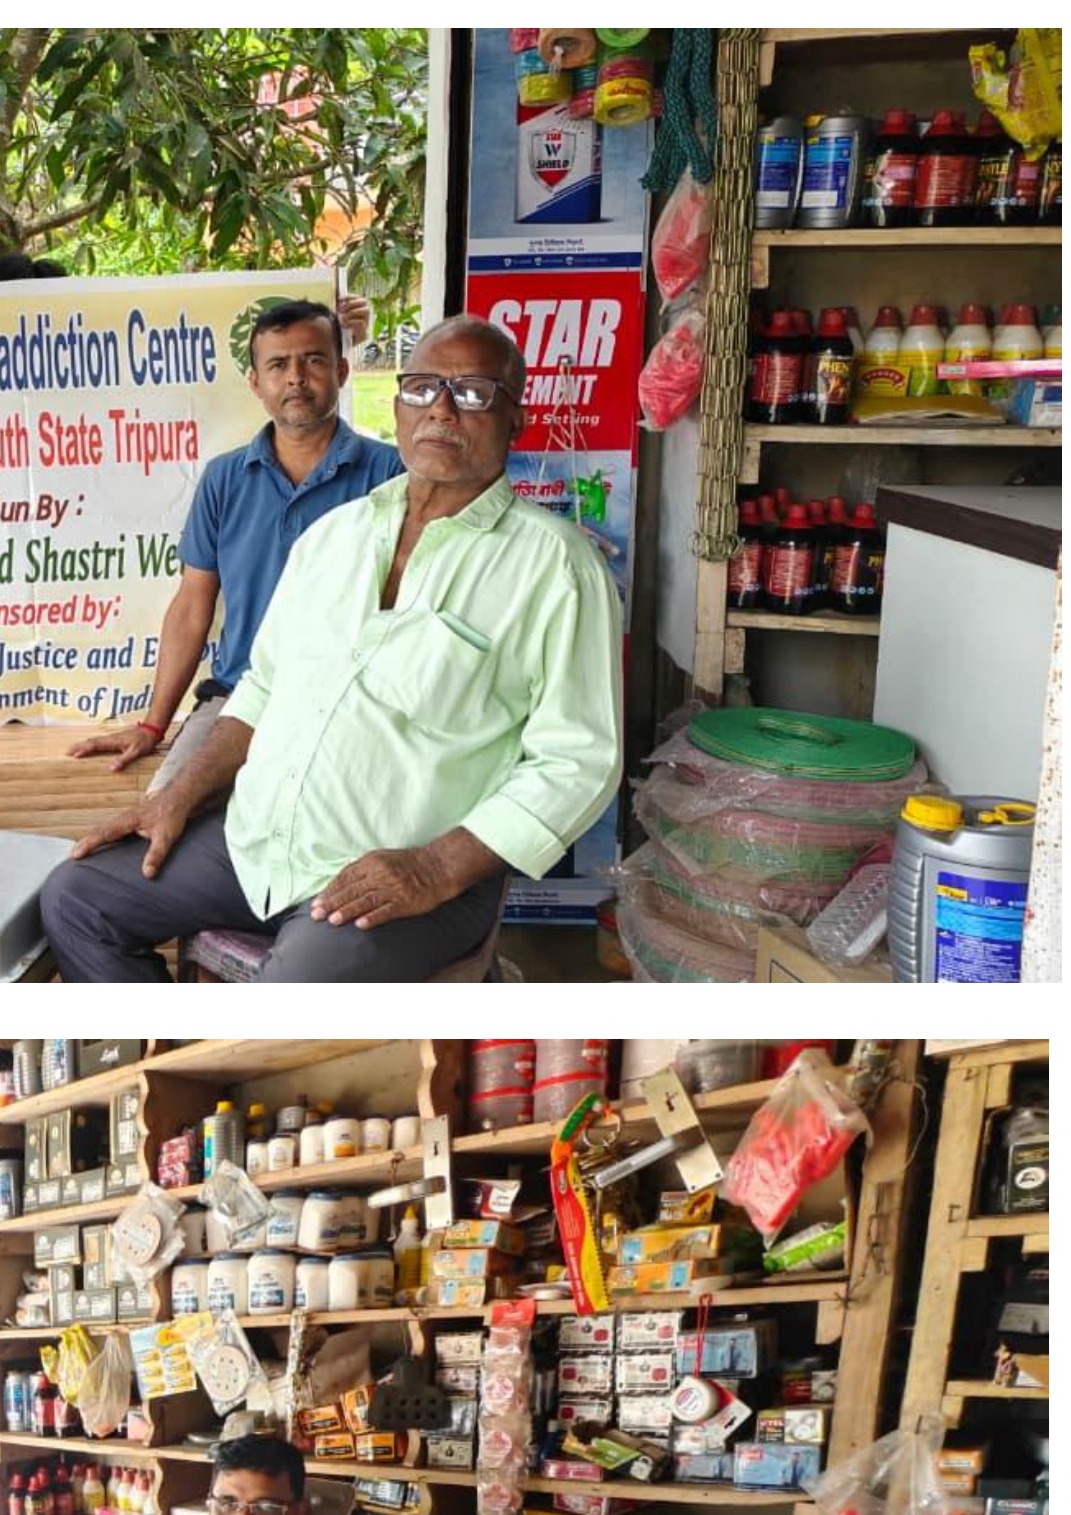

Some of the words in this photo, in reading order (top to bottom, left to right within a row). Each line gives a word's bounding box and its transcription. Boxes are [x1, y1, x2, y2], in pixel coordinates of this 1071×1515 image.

[536, 159, 570, 170] SHIELD
[128, 308, 217, 387] Centre
[488, 298, 622, 368] STAR
[521, 374, 598, 405] EMENT
[37, 410, 103, 467] State
[108, 407, 200, 477] Tripura
[35, 494, 69, 528] By
[25, 532, 126, 583] Shastri
[87, 635, 134, 669] and
[78, 686, 104, 718] of
